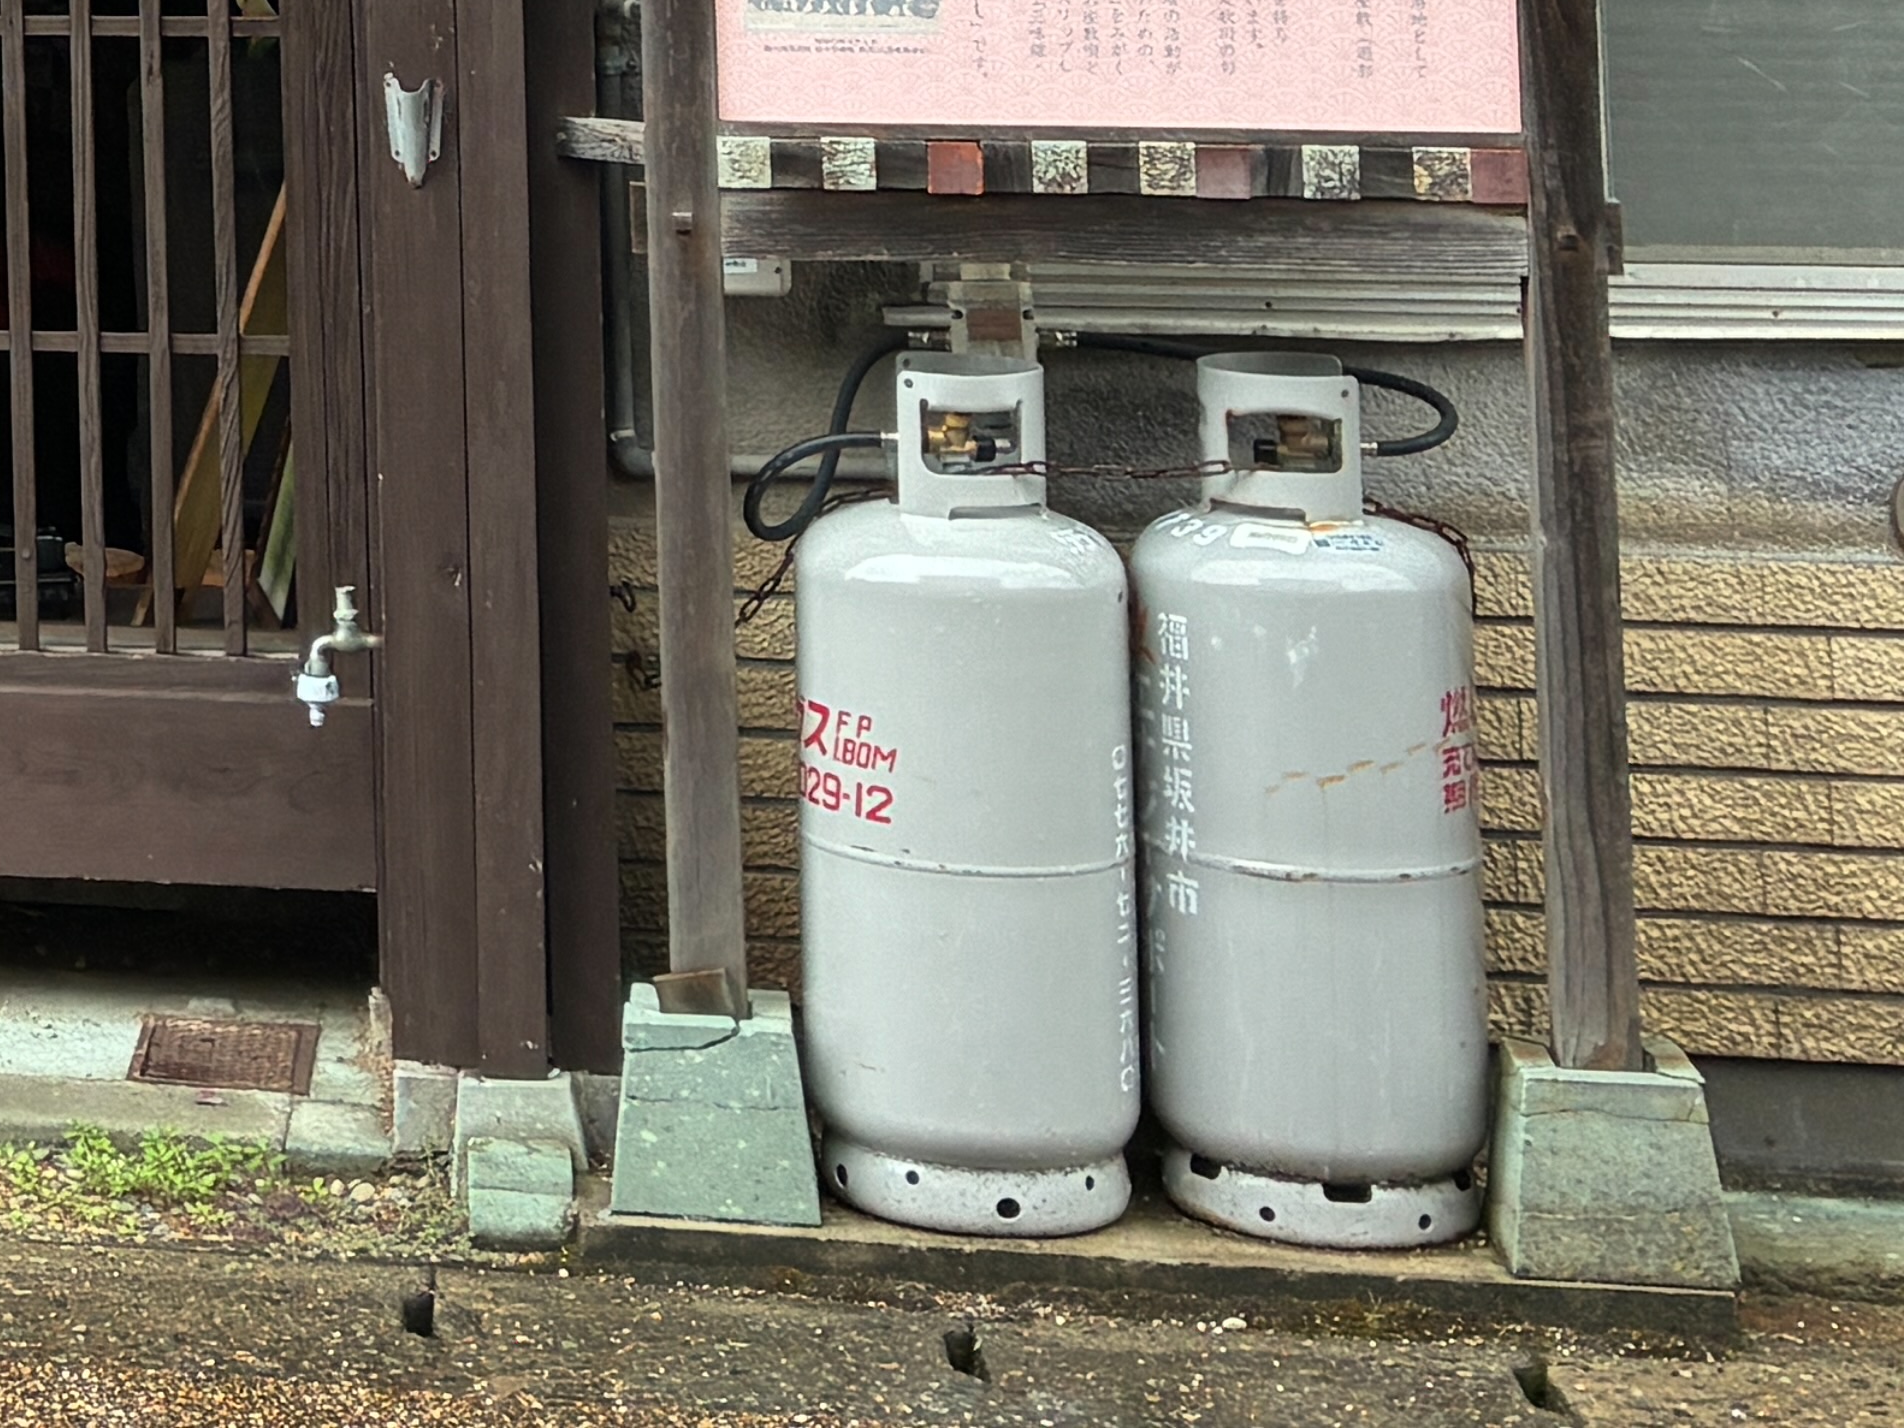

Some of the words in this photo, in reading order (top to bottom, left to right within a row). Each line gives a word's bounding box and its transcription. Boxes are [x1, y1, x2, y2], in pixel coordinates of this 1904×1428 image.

[1157, 611, 1200, 916] 福井県坂井市
